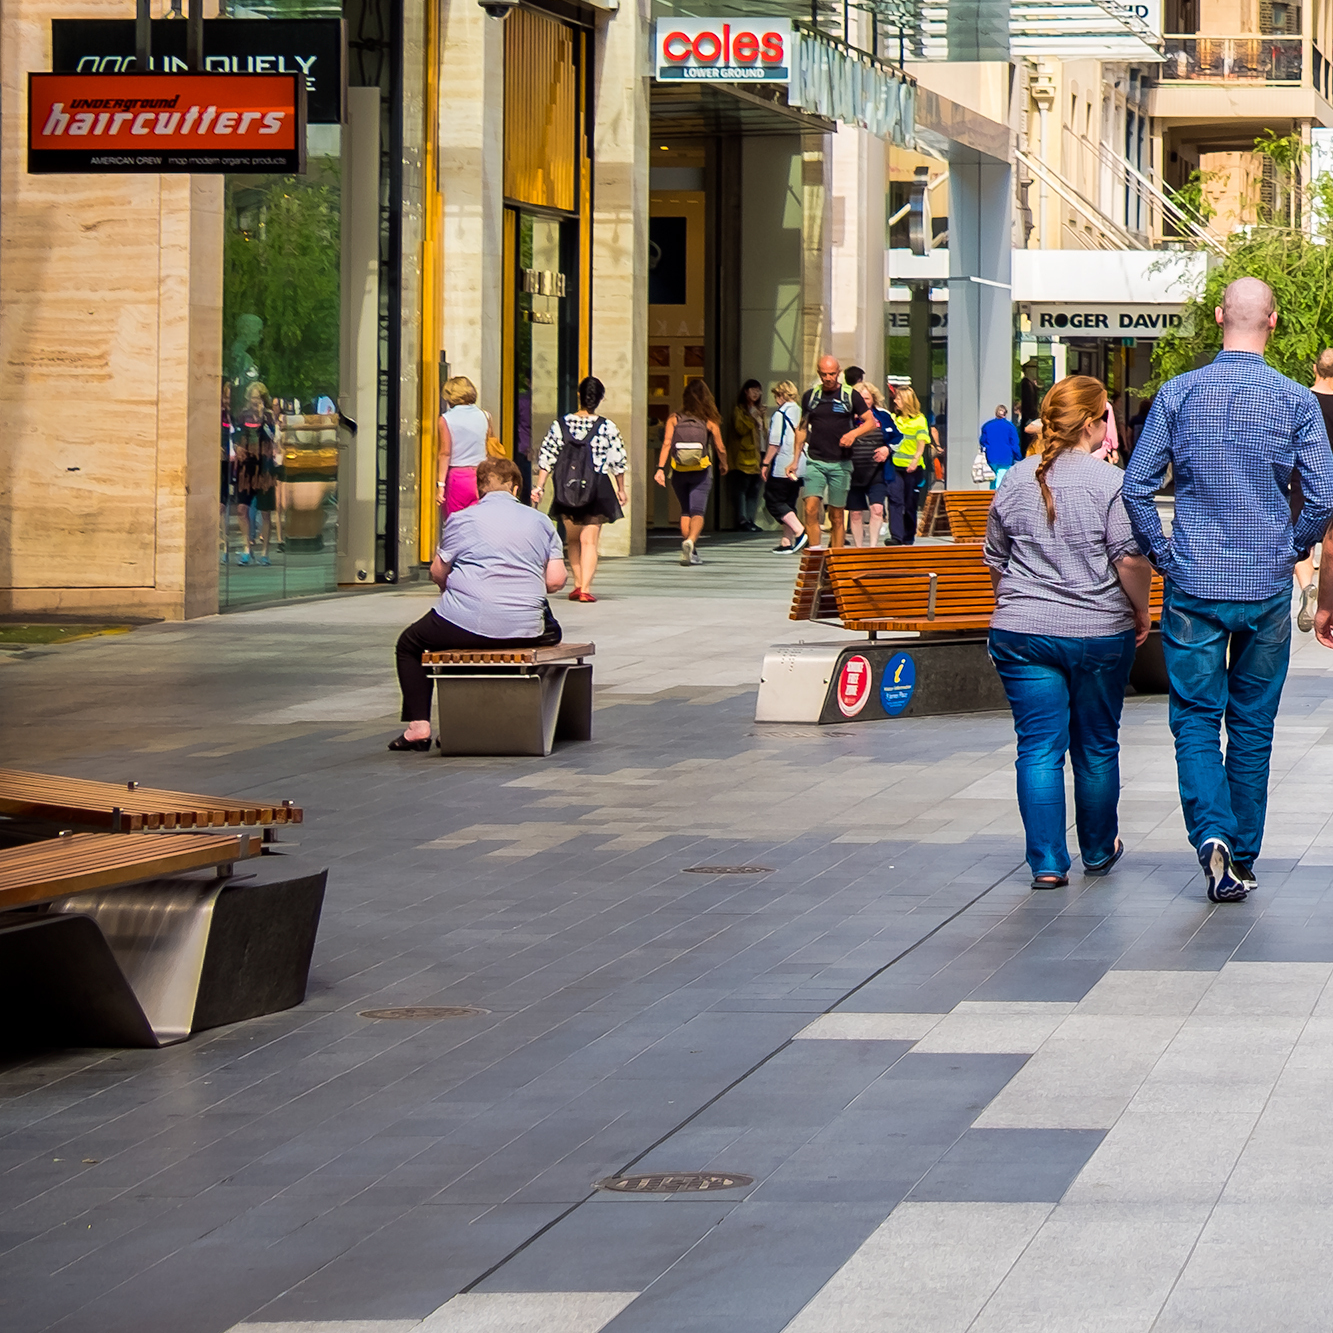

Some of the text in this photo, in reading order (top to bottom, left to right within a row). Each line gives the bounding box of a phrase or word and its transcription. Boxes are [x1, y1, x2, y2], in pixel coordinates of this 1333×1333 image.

[662, 23, 784, 63] coles
[683, 67, 765, 78] LOWER GROUND
[41, 102, 288, 137] haircutters
[136, 156, 163, 165] CREW
[251, 156, 287, 167] products
[1039, 312, 1183, 330] ROGER DAVID
